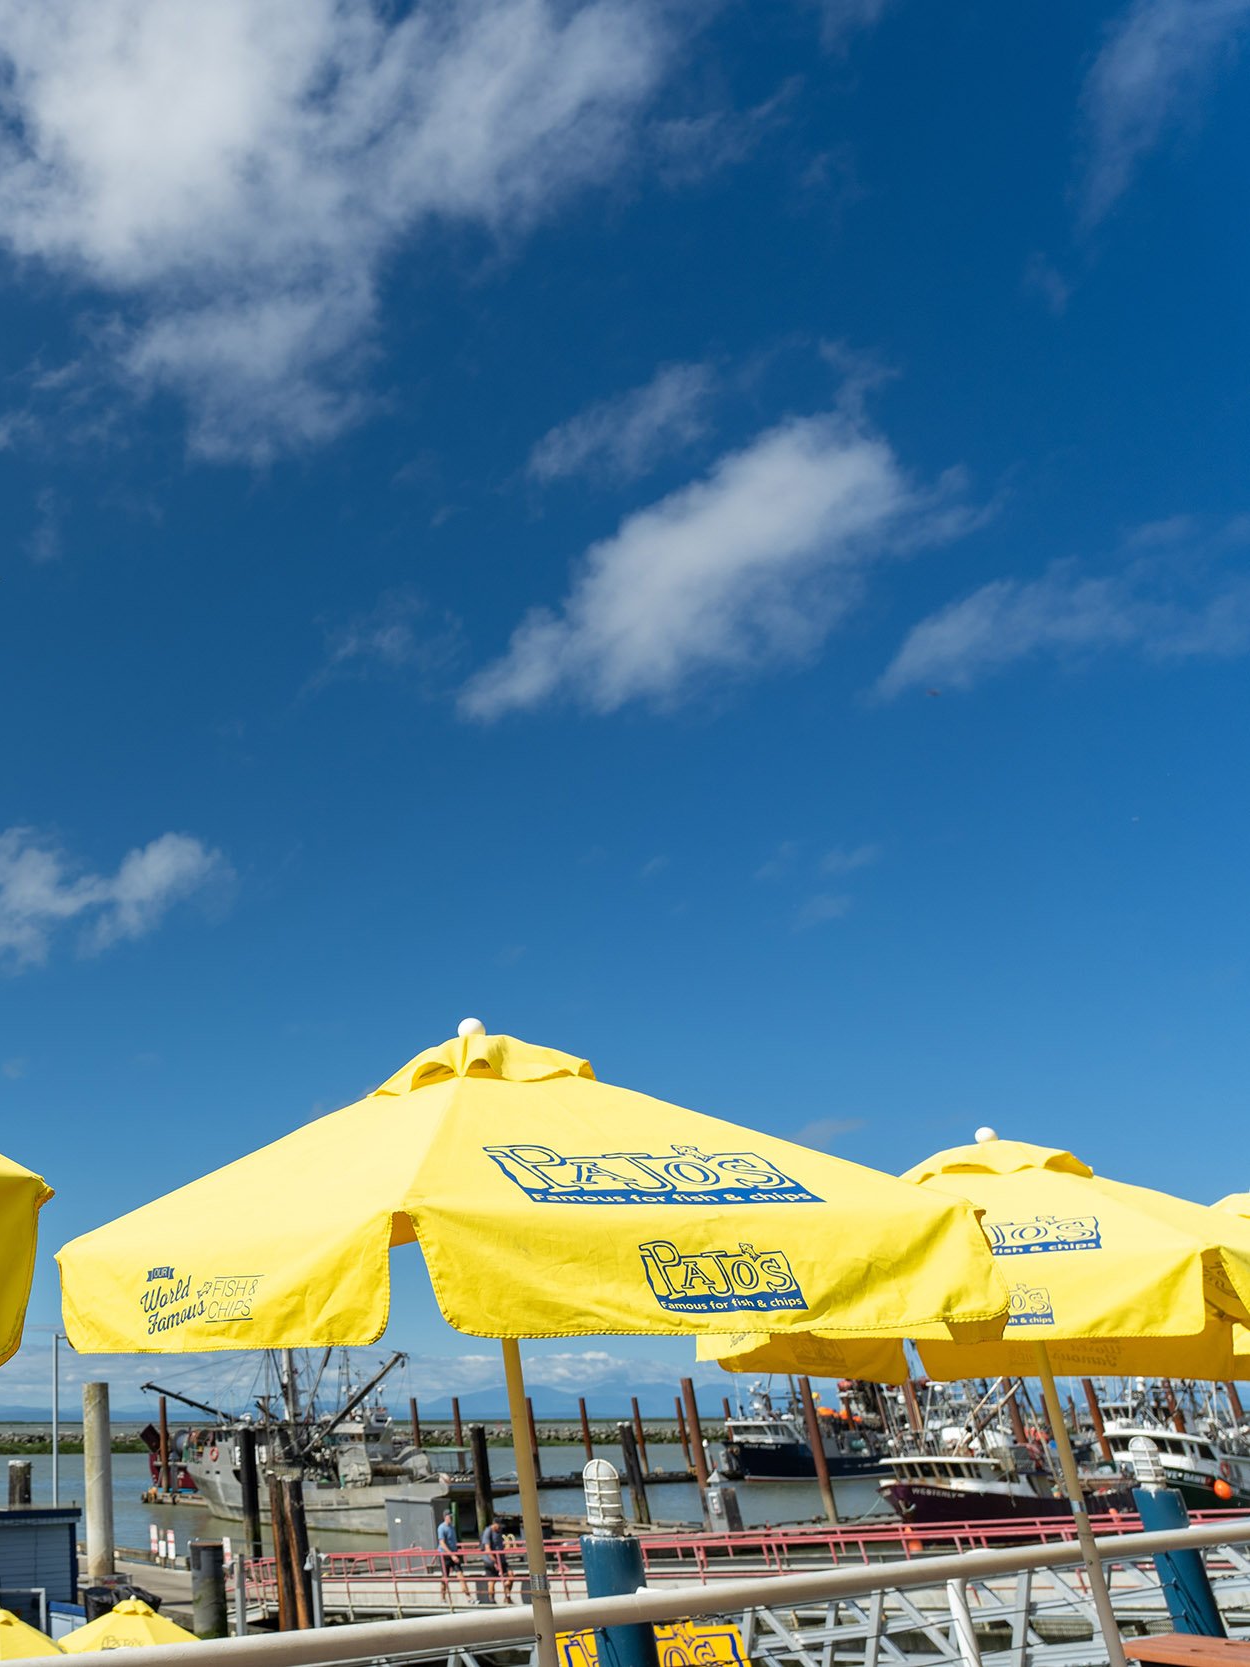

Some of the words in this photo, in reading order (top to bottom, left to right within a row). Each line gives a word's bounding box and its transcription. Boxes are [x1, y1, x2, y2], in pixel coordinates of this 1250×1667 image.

[482, 1144, 786, 1193] PAJO'S
[531, 1193, 626, 1202] Famous
[630, 1194, 667, 1203] for
[672, 1193, 719, 1202] fish
[723, 1193, 746, 1201] &
[749, 1192, 813, 1202] chips
[1048, 1242, 1096, 1251] chips
[639, 1240, 793, 1300] PAJO'S
[140, 1275, 192, 1313] World
[212, 1279, 248, 1298] FISH
[248, 1279, 259, 1296] &
[207, 1298, 253, 1320] CHIPS
[661, 1300, 708, 1310] Famous
[710, 1300, 729, 1310] for
[731, 1297, 754, 1308] fish
[757, 1299, 768, 1308] &
[770, 1297, 803, 1307] chips
[147, 1300, 207, 1335] Famous
